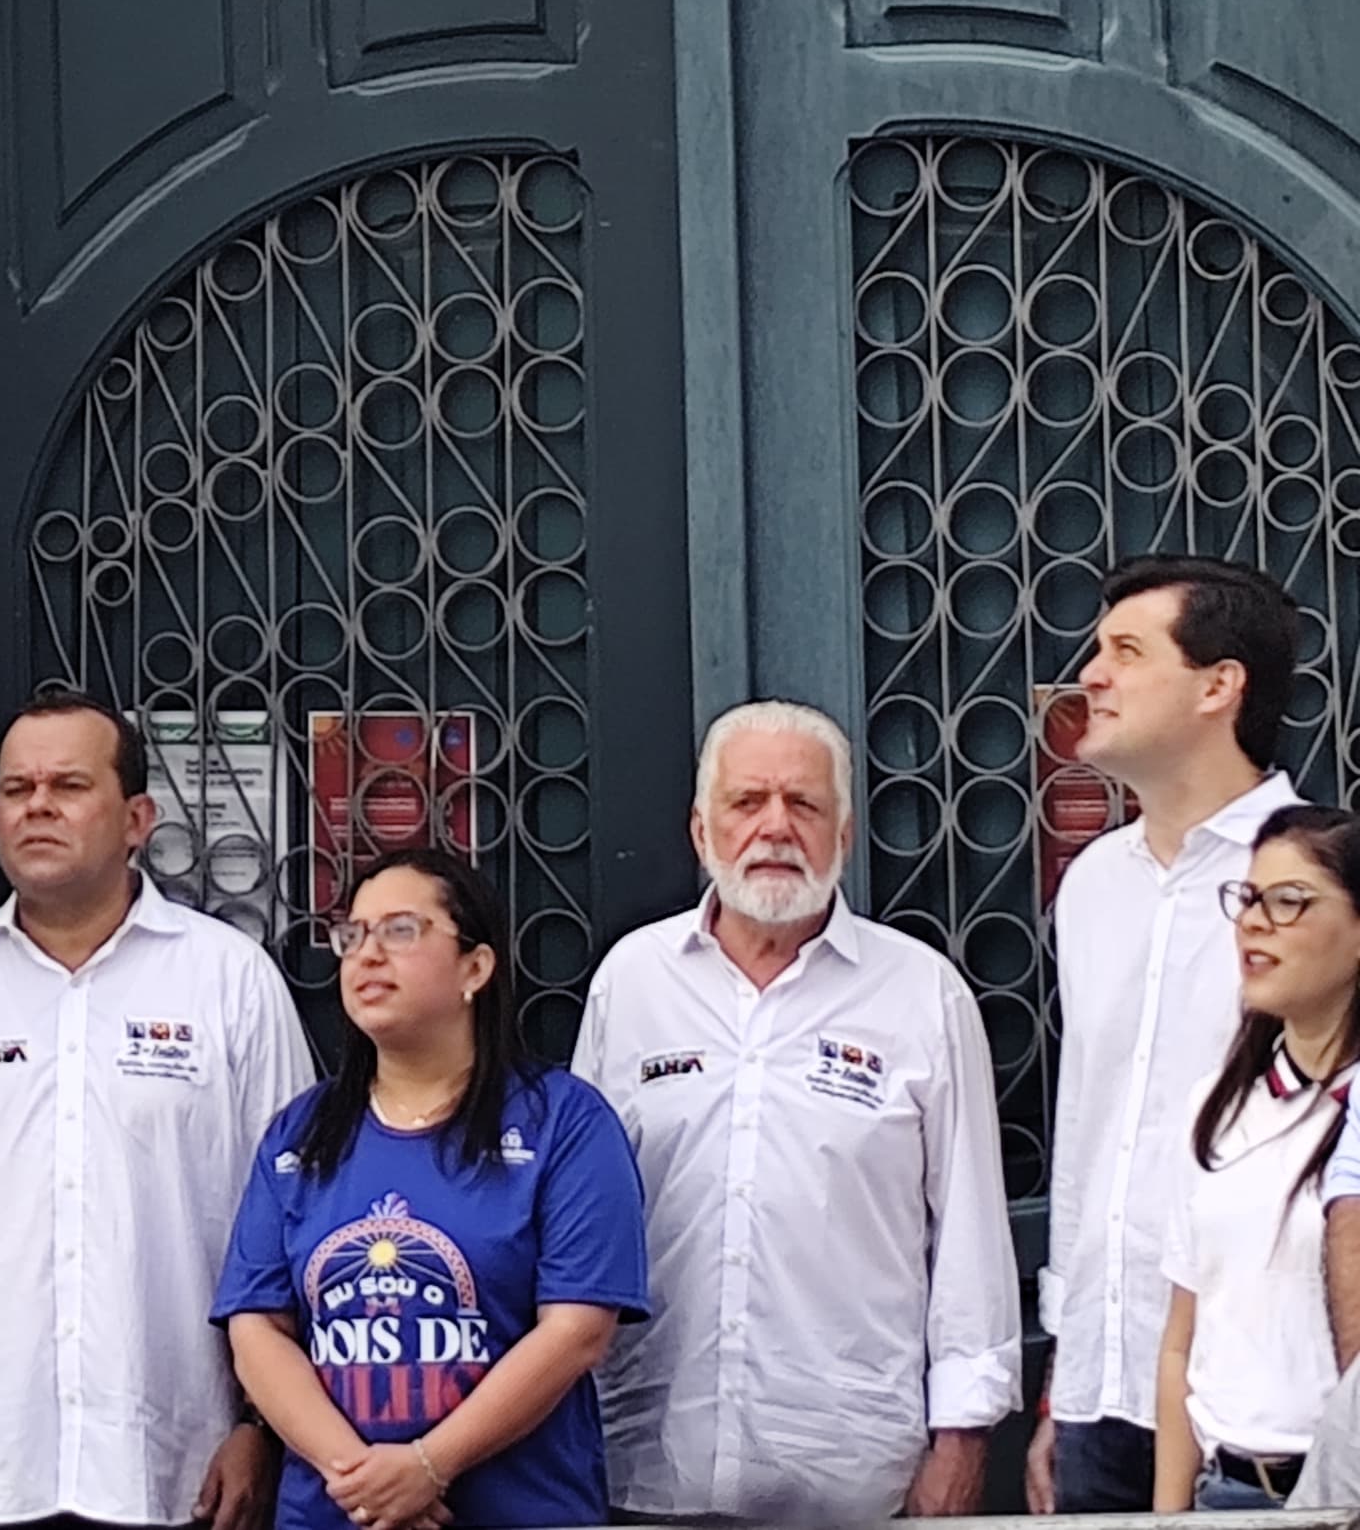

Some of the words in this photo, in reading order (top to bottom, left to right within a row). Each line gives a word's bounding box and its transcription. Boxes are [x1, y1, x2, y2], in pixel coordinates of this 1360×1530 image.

[323, 1281, 355, 1310] EU
[359, 1276, 417, 1298] SOU
[423, 1284, 445, 1306] O
[416, 1317, 491, 1364] DE
